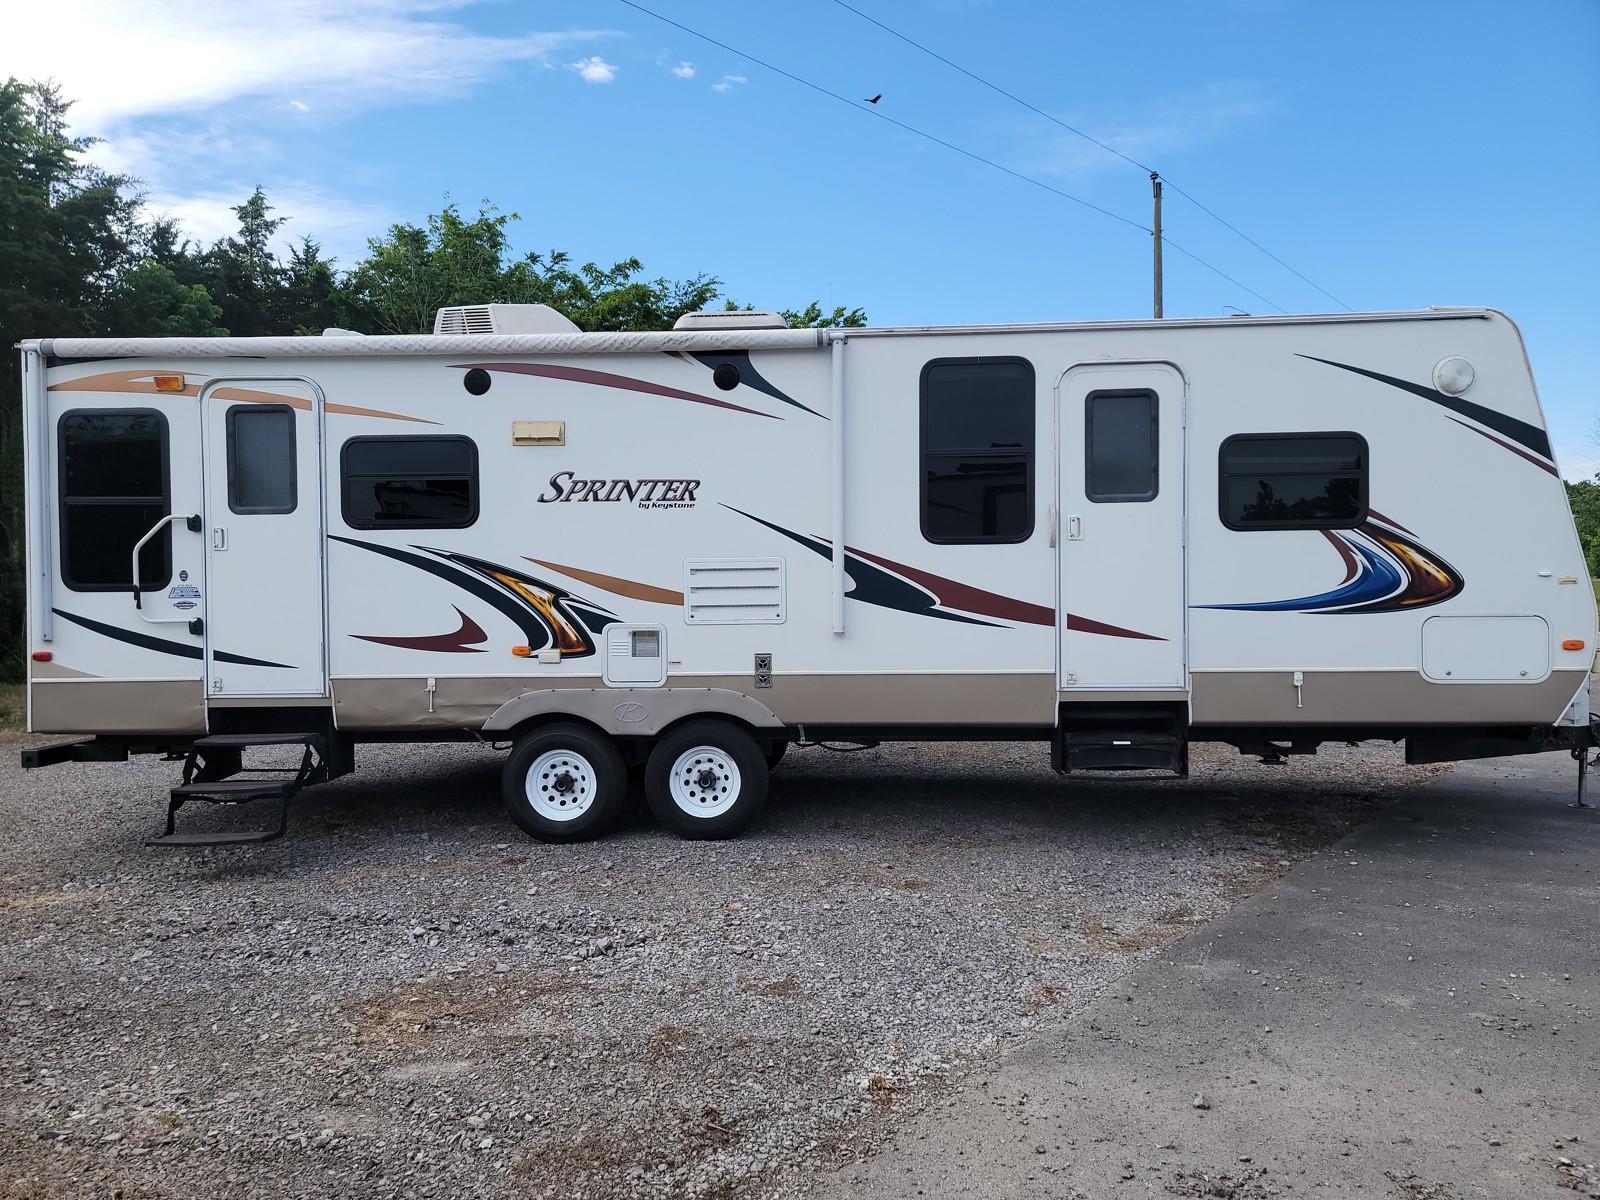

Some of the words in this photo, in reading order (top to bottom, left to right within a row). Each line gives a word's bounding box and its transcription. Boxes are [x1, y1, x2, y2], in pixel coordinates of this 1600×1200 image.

[537, 471, 701, 503] SPRINTER
[638, 502, 650, 510] by
[651, 502, 696, 510] Keystone
